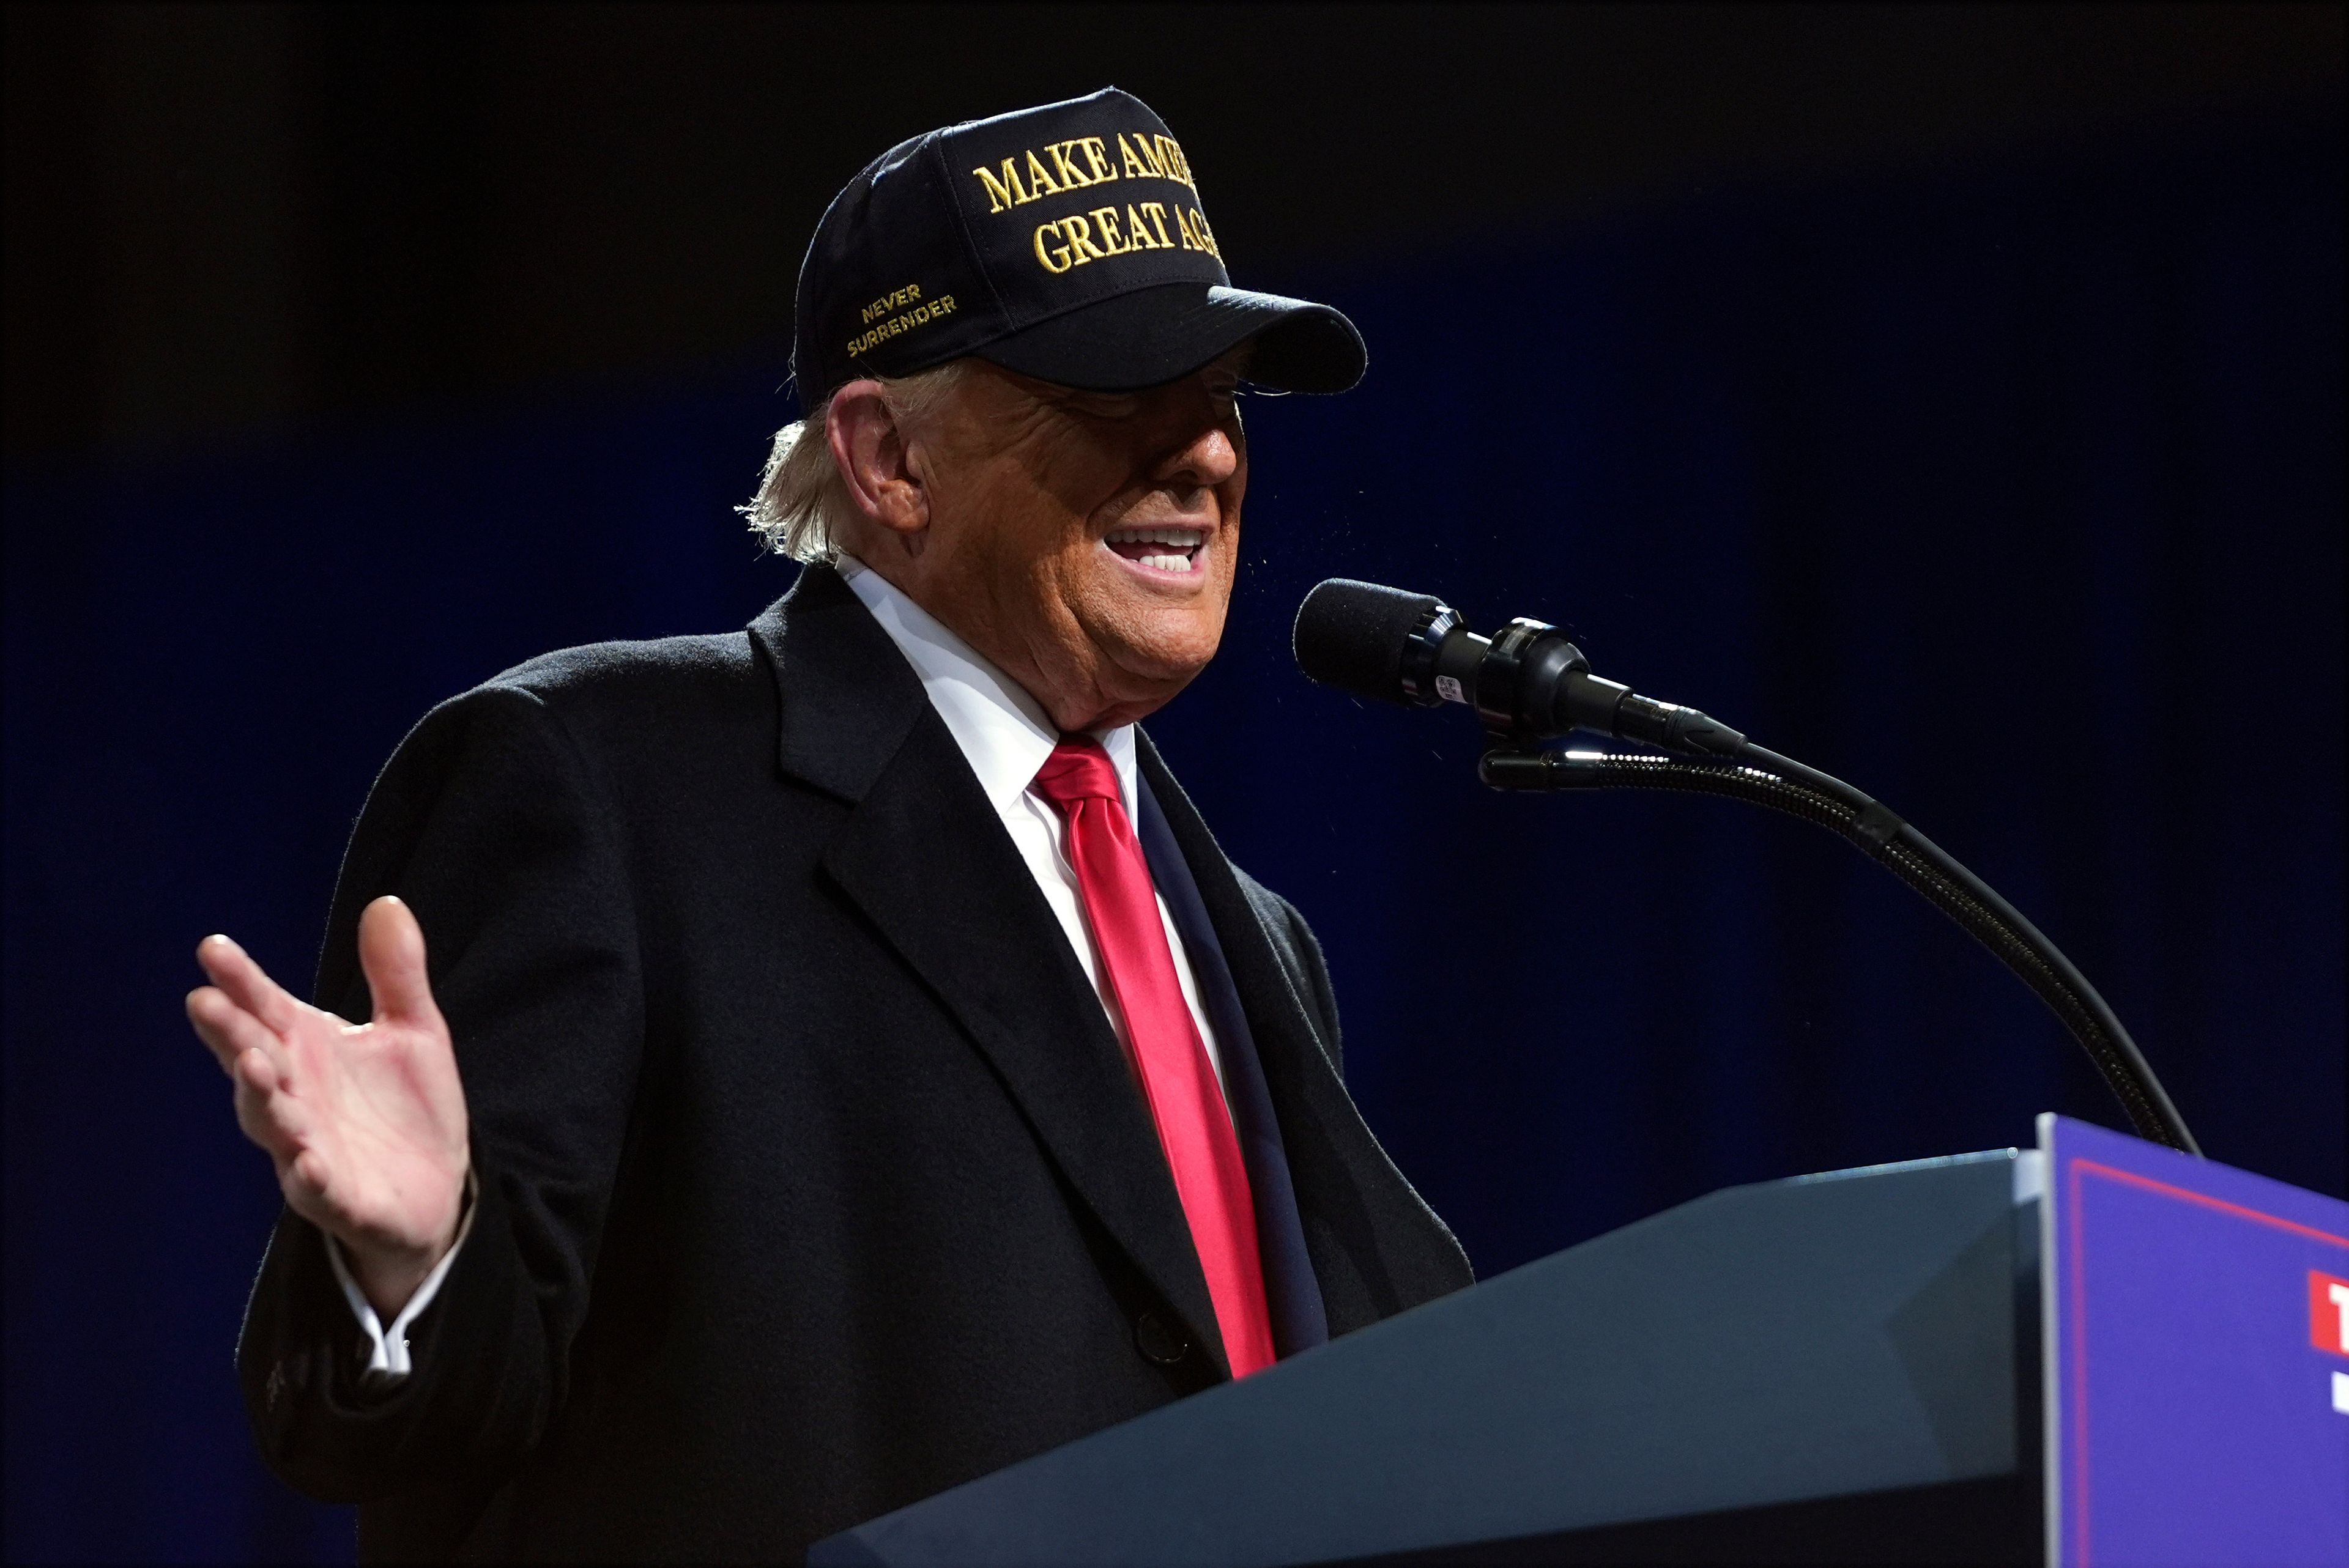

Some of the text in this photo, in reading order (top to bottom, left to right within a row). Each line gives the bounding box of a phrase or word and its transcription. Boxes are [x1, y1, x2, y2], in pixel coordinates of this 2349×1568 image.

[973, 132, 1195, 214] MAKE AME
[1033, 202, 1217, 274] GREAT AG
[847, 295, 957, 358] SURRENDER
[861, 284, 921, 324] NEVER
